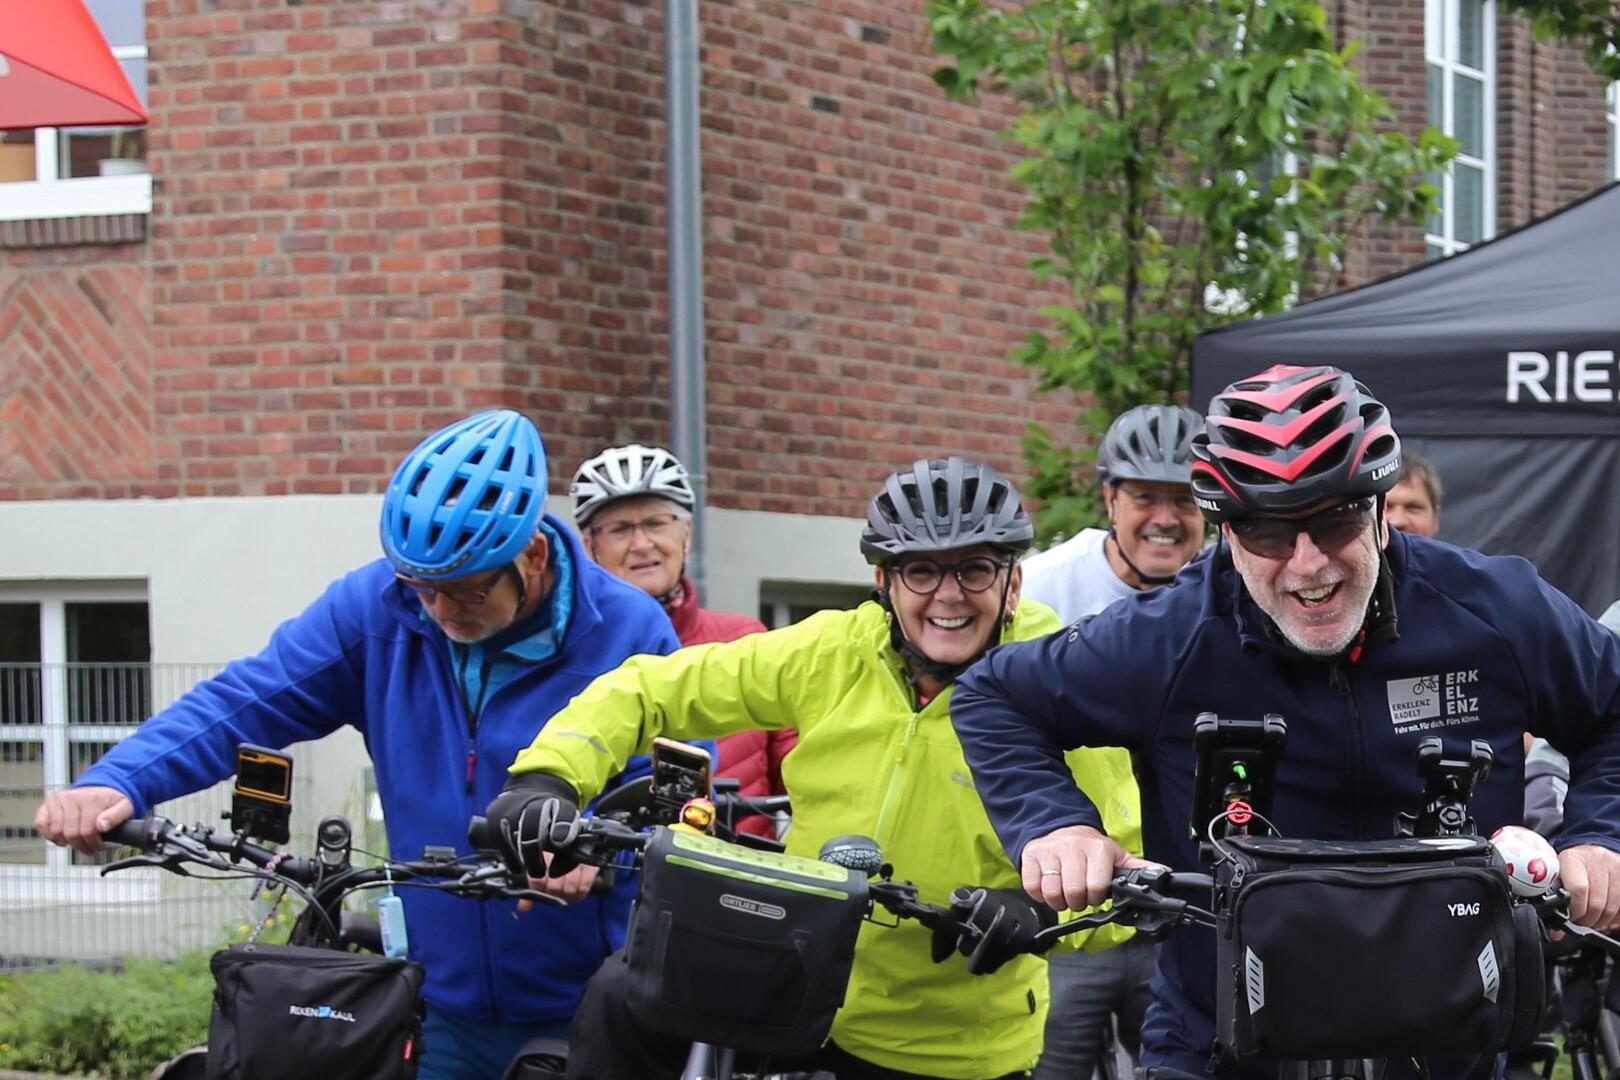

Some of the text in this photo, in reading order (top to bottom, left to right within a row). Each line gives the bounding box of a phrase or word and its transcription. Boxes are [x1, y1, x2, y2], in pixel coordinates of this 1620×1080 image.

[1446, 669, 1479, 685] ERK
[1446, 685, 1465, 700] EL
[1392, 699, 1431, 712] ERKELENZ
[1446, 697, 1479, 715] ENZ
[1394, 709, 1421, 720] RADELT
[1447, 902, 1480, 917] YBAG
